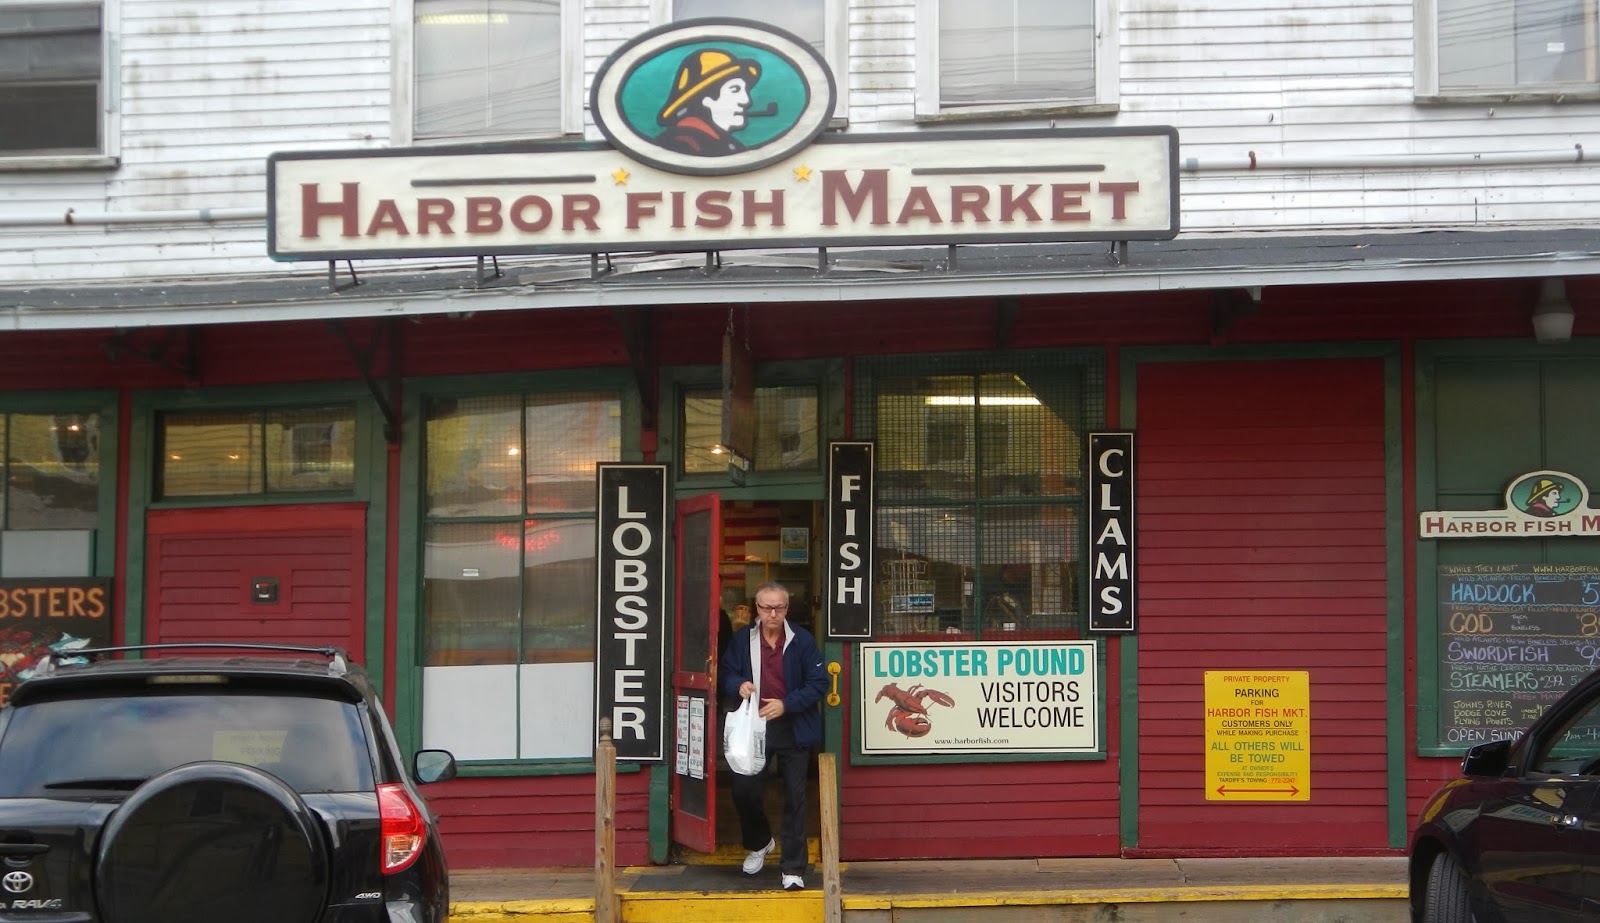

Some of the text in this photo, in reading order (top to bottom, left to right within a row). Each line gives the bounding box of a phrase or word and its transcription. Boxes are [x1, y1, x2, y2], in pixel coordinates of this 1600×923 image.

[300, 168, 1140, 238] HARBOR FISH MARKET
[1095, 448, 1129, 615] CLAMS
[1426, 515, 1600, 533] HARBOR FISH M
[837, 475, 862, 605] FISH
[1451, 583, 1536, 603] HADDOCK
[612, 485, 652, 740] LOBSTER
[1450, 612, 1493, 633] COD
[1448, 642, 1549, 662] SWORDFISH
[874, 648, 1085, 677] LOBSTER POUND
[1223, 675, 1290, 683] PRIVATE PROPERTY
[1450, 671, 1539, 690] STEAMERS
[980, 680, 1080, 703] VISITORS
[1234, 688, 1280, 698] PARKING
[1487, 700, 1512, 709] RIVER
[977, 706, 1085, 728] WELCOME
[1207, 708, 1308, 718] HARBOR FISH MKT.
[1454, 709, 1507, 717] DODGE COVE
[1221, 720, 1293, 728] CUSTOMERS ONLY
[1454, 717, 1513, 726] FLYING POINTS
[934, 737, 1009, 745] www.harborfish.com
[1447, 728, 1485, 742] OPEN
[1211, 741, 1304, 751] ALL OTHERS WILL
[1229, 753, 1285, 763] BE TOWED
[11, 898, 62, 909] RAV4
